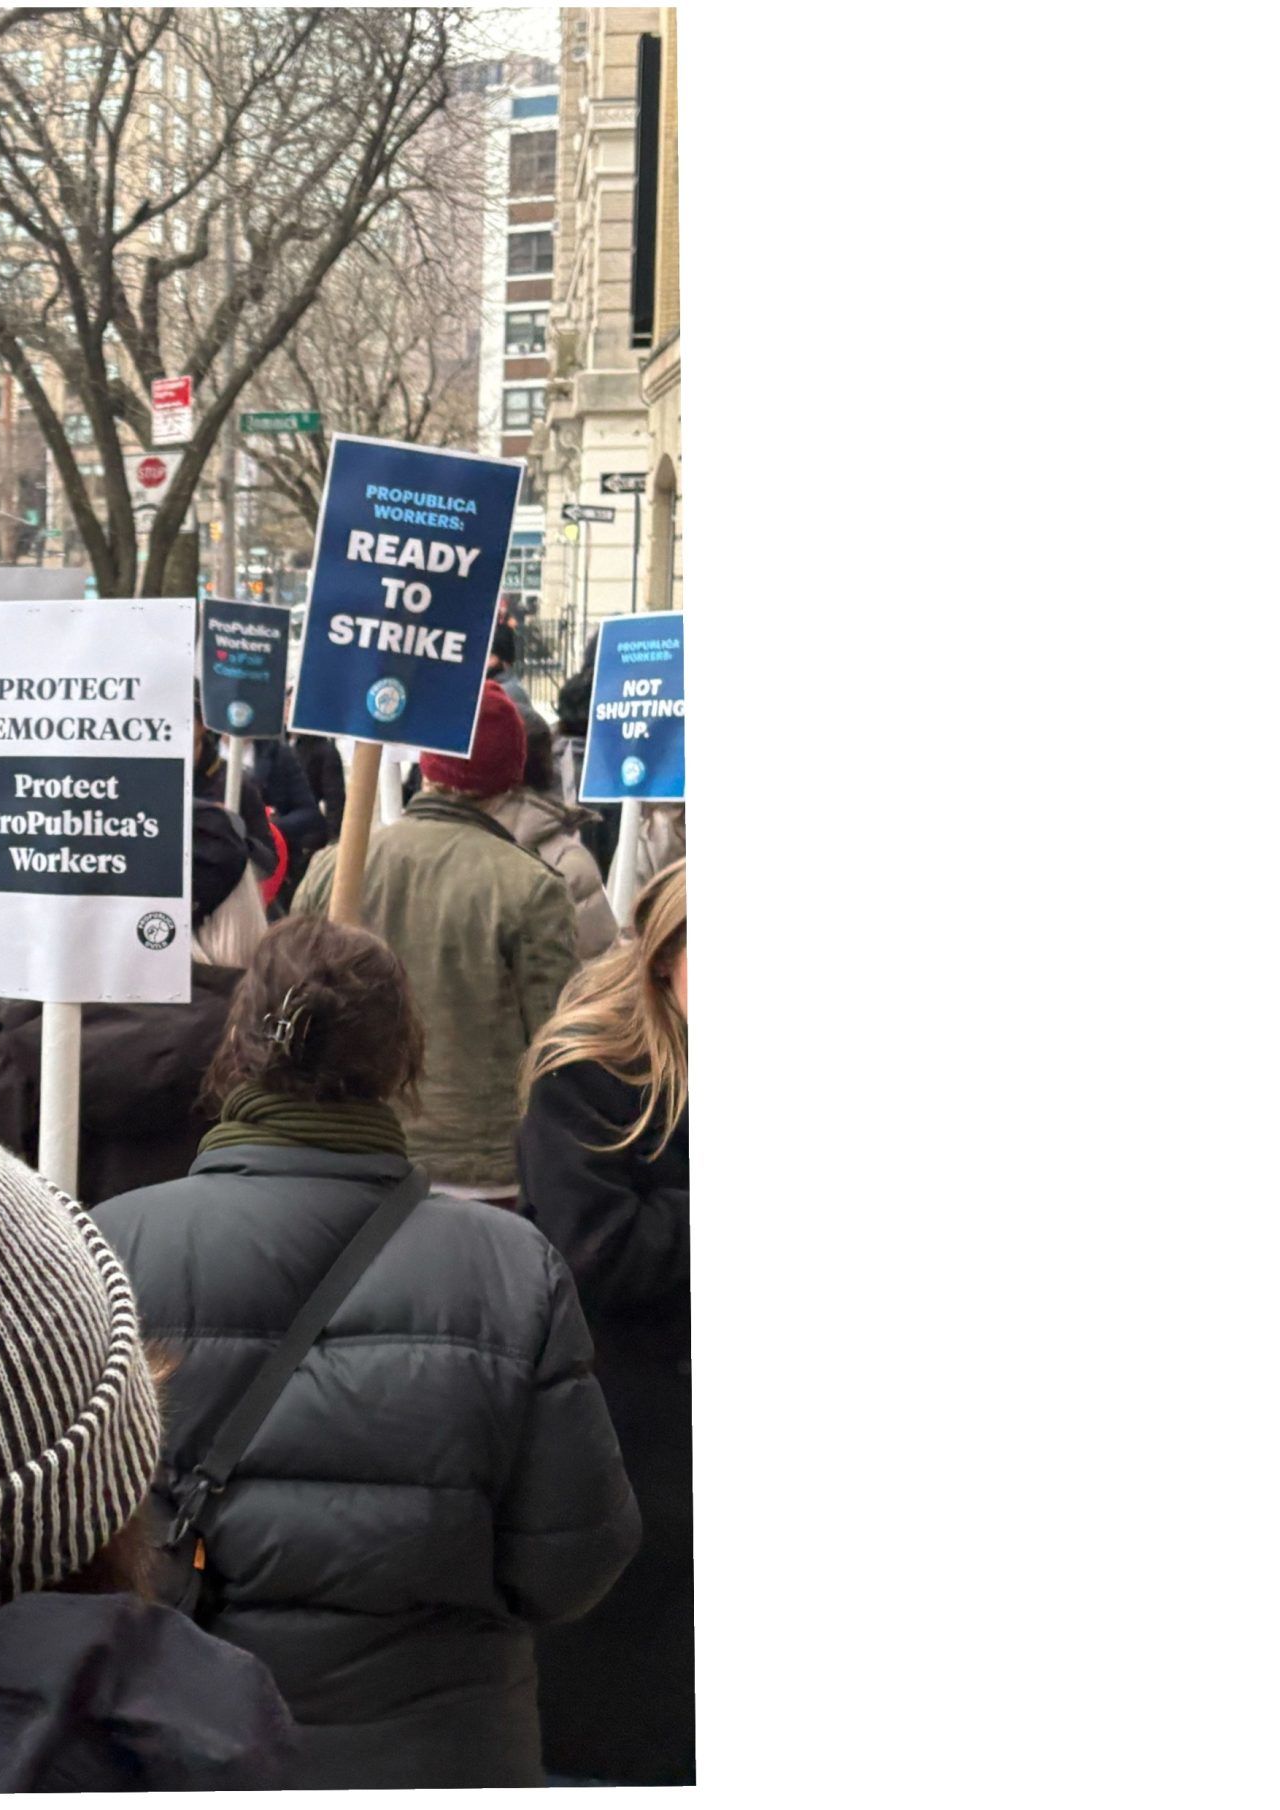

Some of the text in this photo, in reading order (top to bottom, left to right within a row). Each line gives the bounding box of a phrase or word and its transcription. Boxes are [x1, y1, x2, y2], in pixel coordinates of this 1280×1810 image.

[138, 465, 165, 480] STOP
[365, 484, 478, 515] PROPUBLICA
[373, 503, 465, 531] WORKERS:
[346, 529, 481, 577] READY
[381, 577, 432, 614] TO
[208, 618, 281, 639] ProPublica
[328, 614, 467, 663] STRIKE
[214, 633, 271, 653] Workers
[617, 638, 680, 653] PROPUBLICA
[622, 678, 663, 698] NOT
[595, 699, 686, 721] SHUTTING
[621, 721, 650, 740] UP.
[13, 773, 120, 799] Protect
[8, 846, 127, 874] Workers
